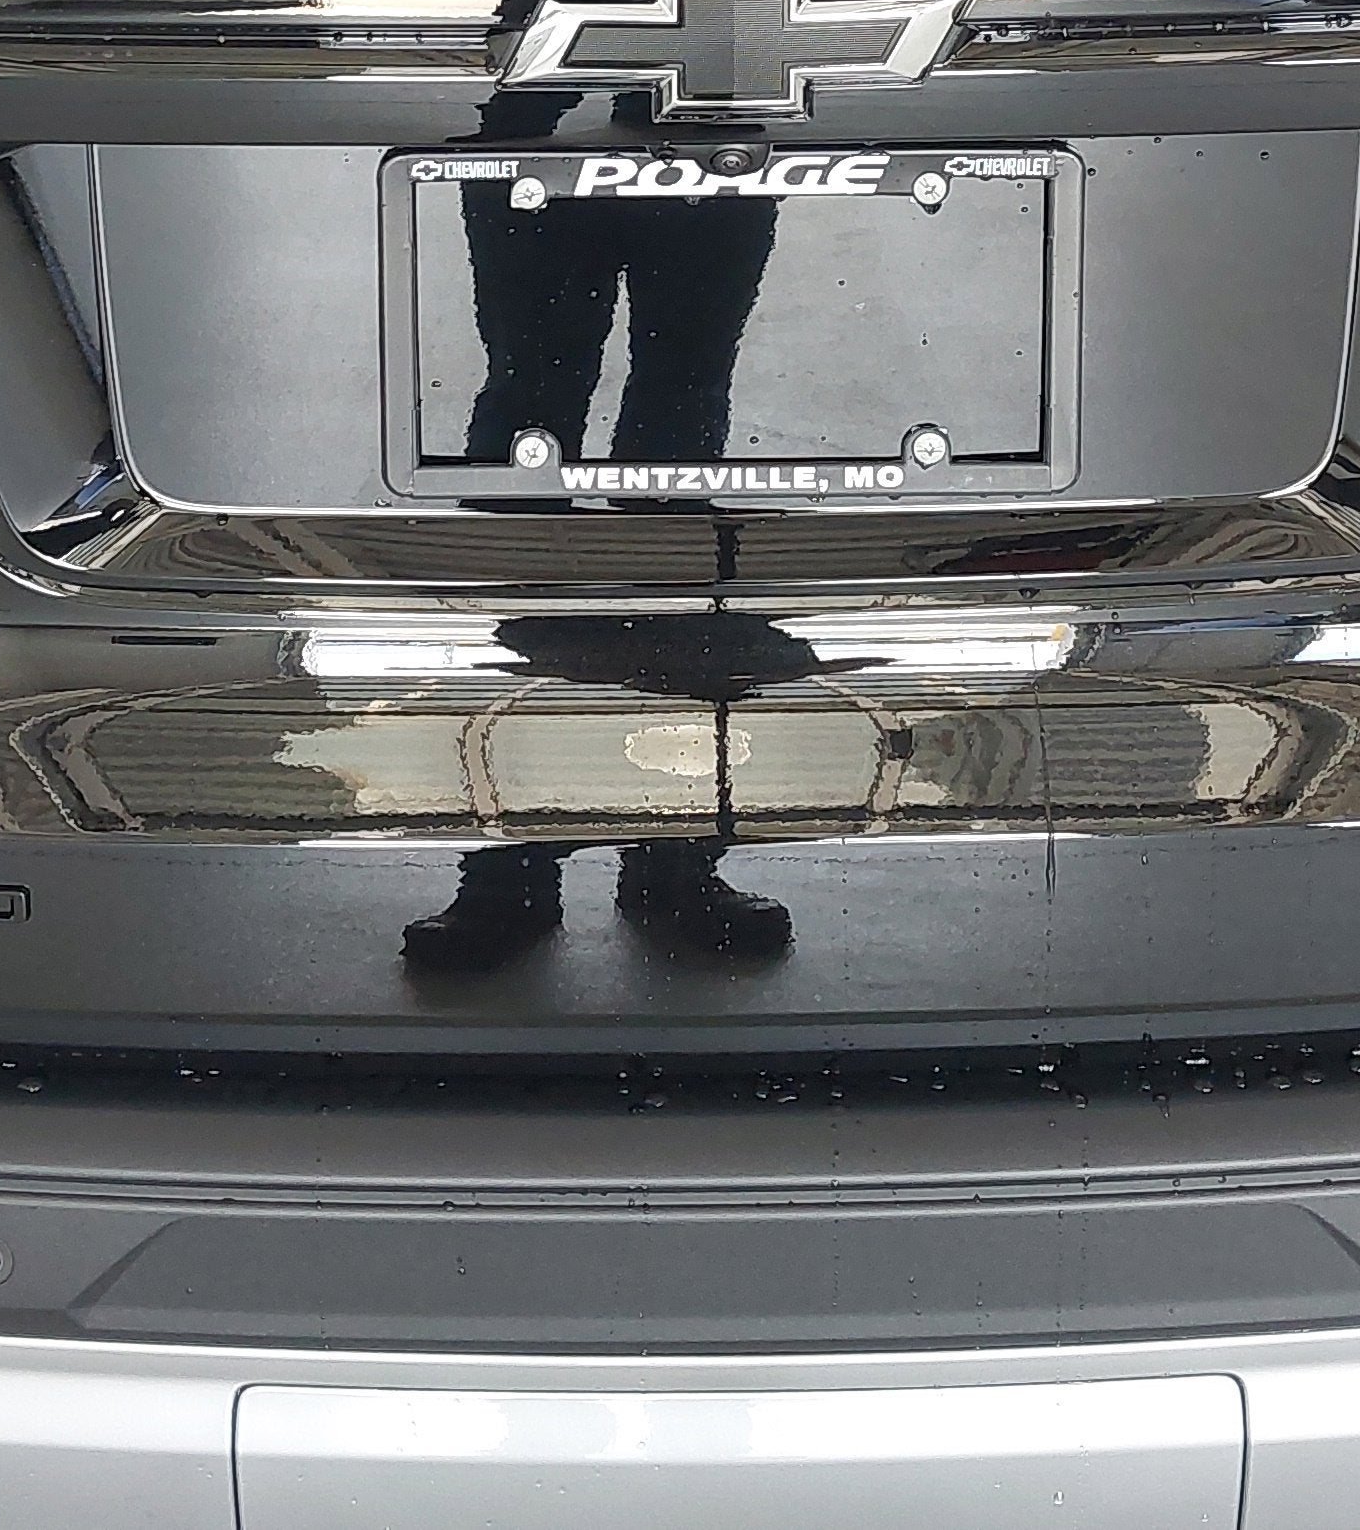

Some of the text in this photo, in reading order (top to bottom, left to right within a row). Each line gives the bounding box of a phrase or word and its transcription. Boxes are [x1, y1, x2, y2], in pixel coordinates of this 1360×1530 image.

[444, 160, 520, 179] CHEVROLET
[573, 155, 891, 198] POAGE
[974, 156, 1051, 177] CHEVROLET
[560, 465, 905, 494] WENTZVILLE, MO
